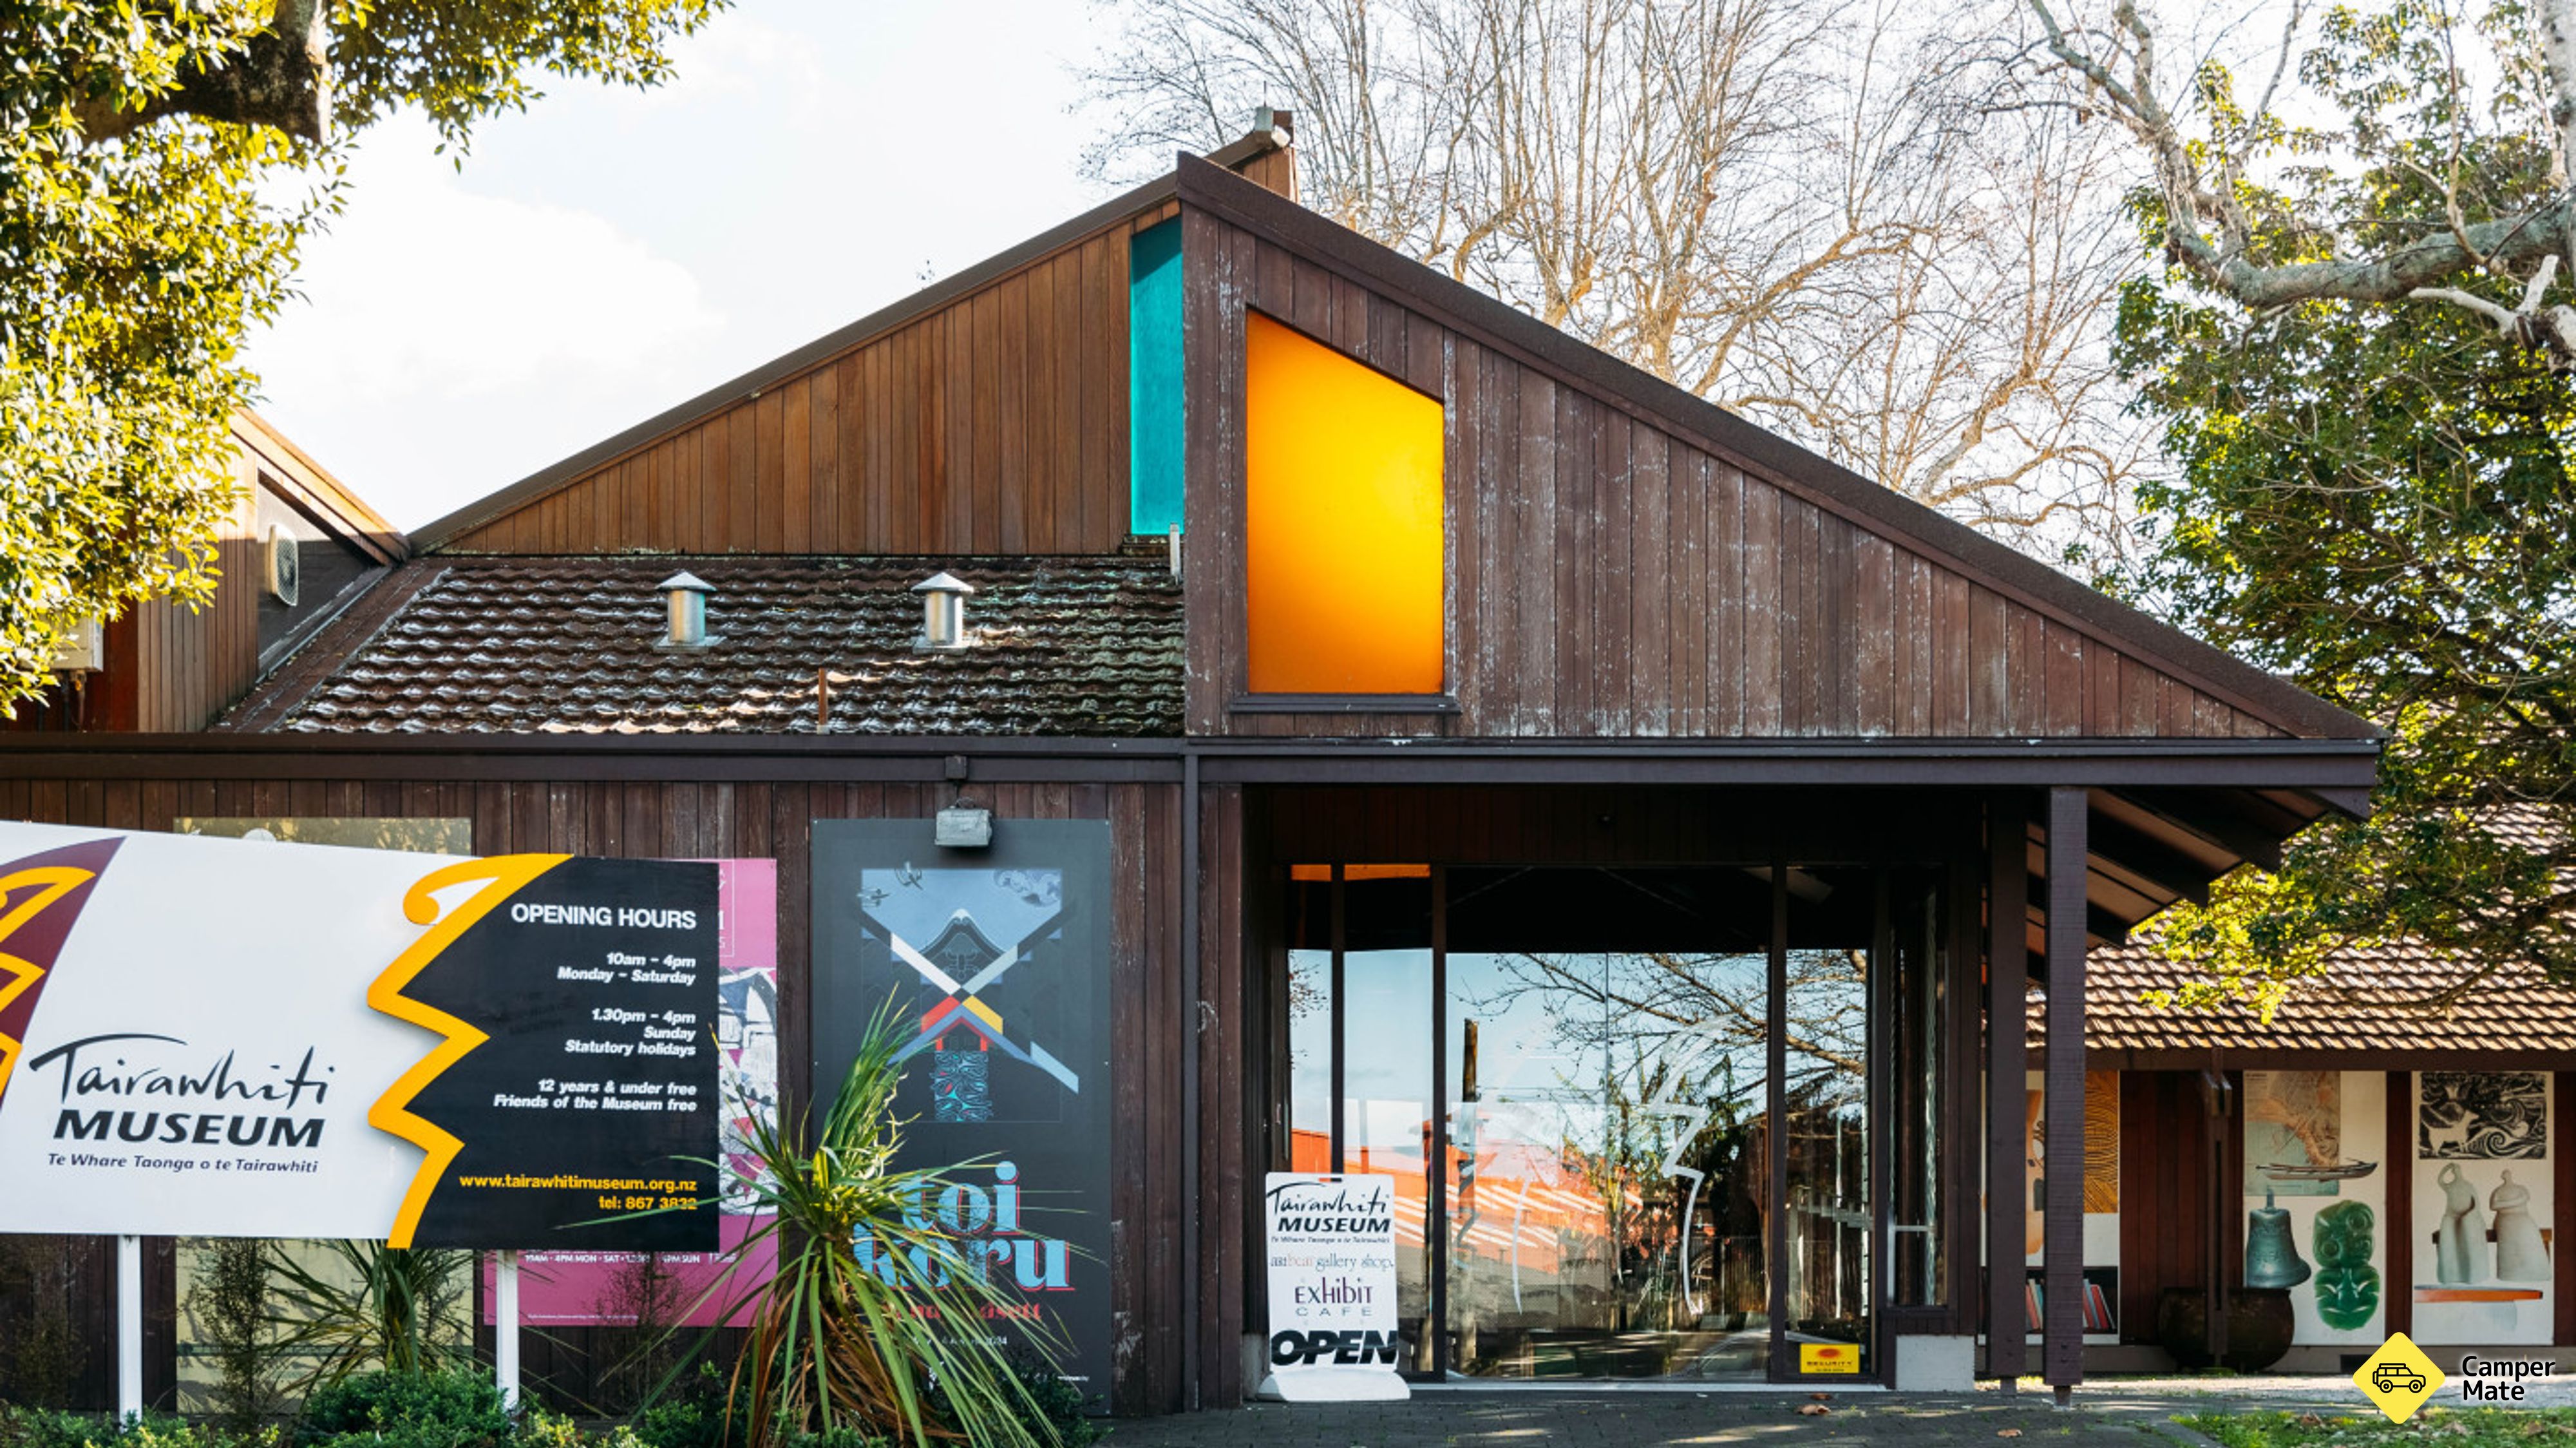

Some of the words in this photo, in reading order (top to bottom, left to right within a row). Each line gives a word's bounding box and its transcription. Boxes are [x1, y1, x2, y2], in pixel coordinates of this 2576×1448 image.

[511, 903, 612, 926] OPENING
[618, 908, 696, 929] HOURS
[606, 952, 645, 966] 10am
[663, 955, 696, 969] 4pm
[557, 966, 614, 983] Monday
[631, 969, 696, 986] Saturday
[592, 1008, 646, 1024] 1.30pm
[663, 1010, 696, 1025] 4pm
[643, 1026, 696, 1042] Sunday
[565, 1040, 634, 1056] Statutory
[638, 1042, 696, 1058] holidays
[29, 1034, 335, 1109] Tairawhiti
[538, 1079, 555, 1092] 12
[559, 1083, 600, 1094] years
[604, 1081, 615, 1094] &
[620, 1081, 663, 1095] under
[667, 1082, 697, 1096] free
[493, 1094, 548, 1109] Friends
[553, 1096, 570, 1109] of
[574, 1096, 598, 1110] the
[601, 1096, 663, 1111] Museum
[667, 1098, 697, 1112] free
[53, 1109, 325, 1148] MUSEUM
[48, 1153, 66, 1165] Te
[71, 1154, 127, 1167] Whare
[134, 1155, 194, 1172] Taonga
[200, 1160, 209, 1169] o
[216, 1159, 231, 1170] te
[236, 1159, 319, 1173] Tairawhiti
[459, 1174, 697, 1194] www.tairawhitimuseum.org.nz
[599, 1196, 621, 1210] tel:
[625, 1196, 652, 1210] 867
[659, 1197, 697, 1210] 3832
[900, 1161, 1021, 1235] toi
[1266, 1181, 1390, 1215] Tairawhiti
[1278, 1217, 1391, 1233] MUSEUM
[604, 1255, 620, 1263] SAT
[1315, 1253, 1357, 1272] gallery
[1295, 1306, 1373, 1317] CAFE
[1271, 1329, 1398, 1366] OPEN
